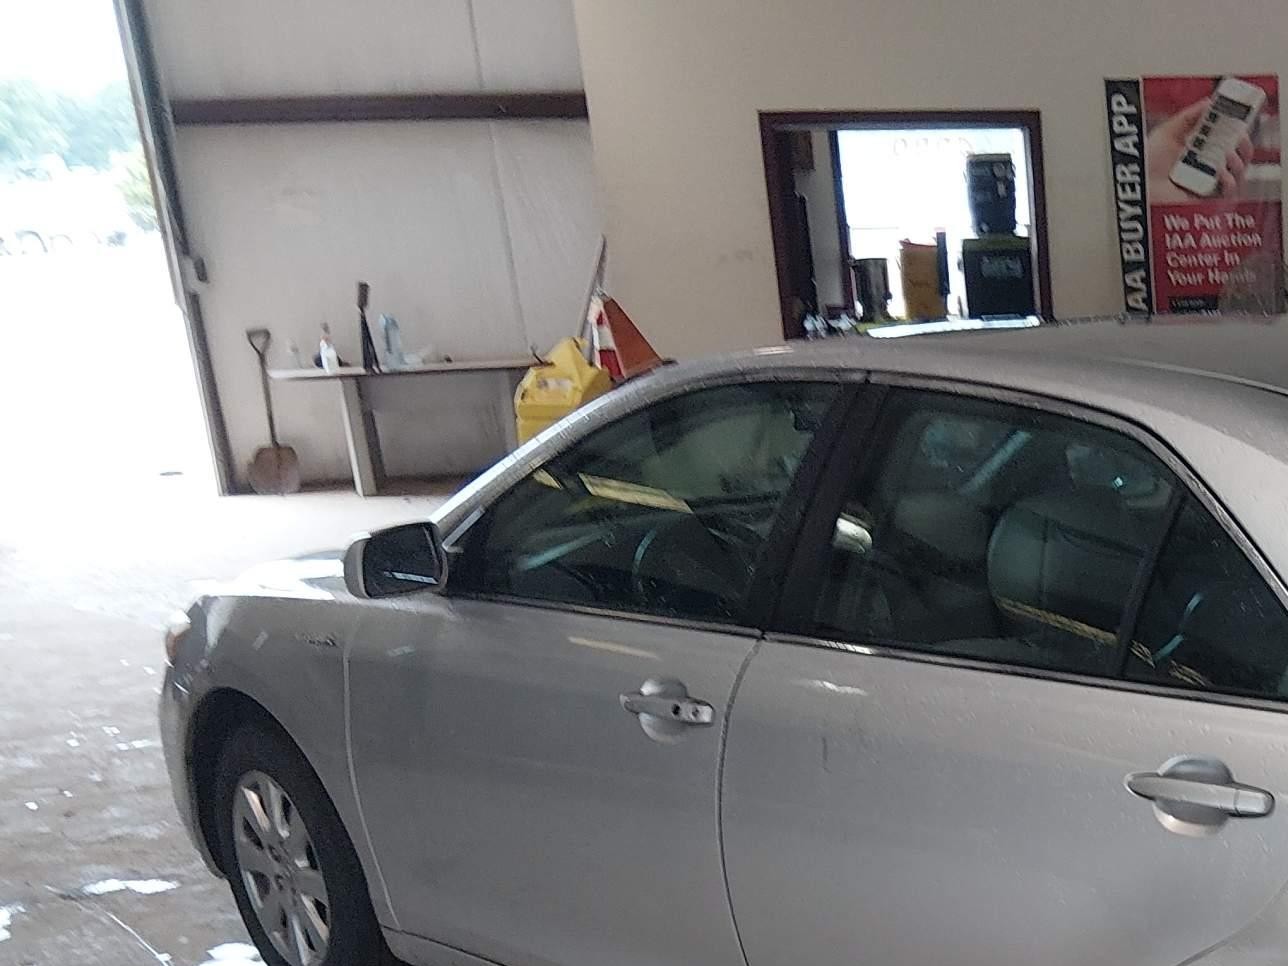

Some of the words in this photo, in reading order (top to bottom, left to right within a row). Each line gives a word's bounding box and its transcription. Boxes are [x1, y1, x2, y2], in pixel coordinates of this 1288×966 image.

[1110, 92, 1140, 157] APP
[1115, 162, 1146, 262] BUYER
[1163, 213, 1190, 231] We
[1193, 212, 1222, 231] Put
[1223, 211, 1255, 230] The
[1164, 232, 1198, 250] IAA
[1199, 230, 1262, 249] Auction
[1166, 250, 1222, 268] Center
[1223, 249, 1241, 266] In
[1167, 268, 1206, 287] Your
[1125, 268, 1148, 313] AA
